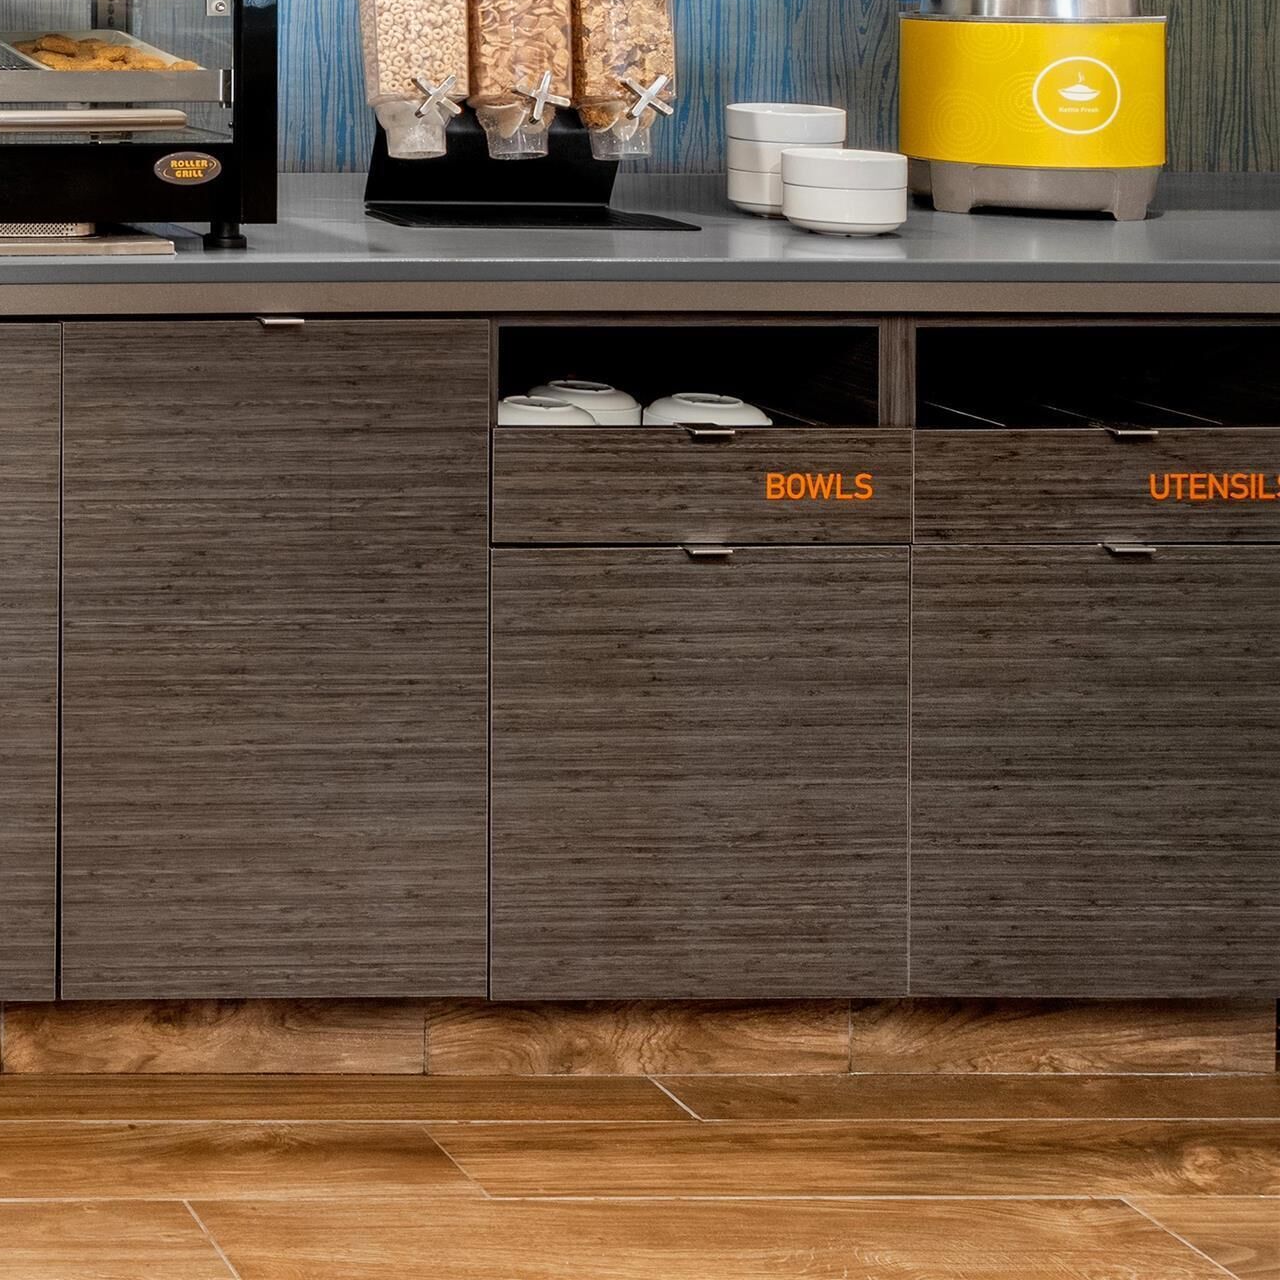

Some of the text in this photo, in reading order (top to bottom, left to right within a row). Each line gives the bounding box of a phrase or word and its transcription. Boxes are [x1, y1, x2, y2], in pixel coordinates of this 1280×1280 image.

[171, 160, 208, 168] ROLLER
[175, 170, 204, 178] GRILL
[766, 472, 874, 500] BOWLS
[1149, 472, 1280, 500] UTENSIL
